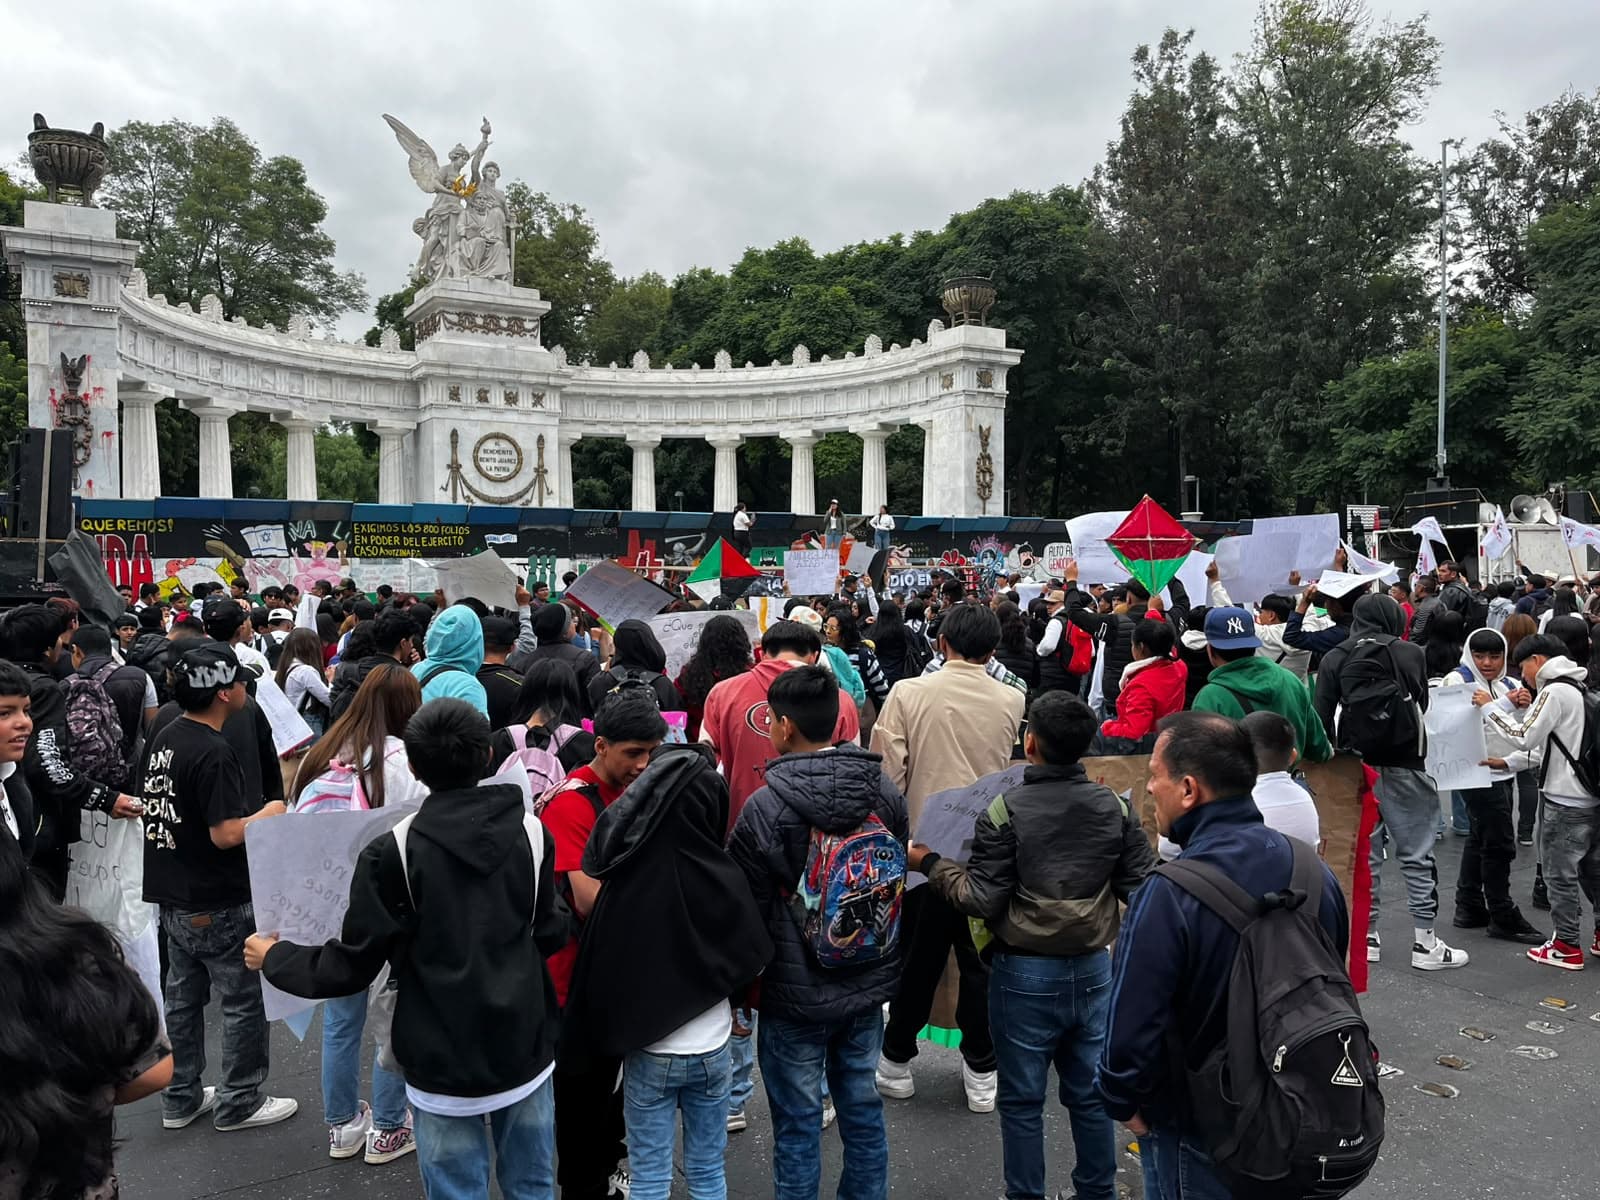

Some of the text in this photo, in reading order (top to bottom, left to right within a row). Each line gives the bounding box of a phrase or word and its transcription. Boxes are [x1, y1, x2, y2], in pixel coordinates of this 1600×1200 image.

[353, 523, 399, 534] EXIGIMOS
[401, 523, 422, 534] LOS
[423, 524, 440, 535] 800
[440, 525, 471, 535] FOLIOS
[354, 535, 465, 547] EN PODER DEL EJERCITO
[353, 545, 379, 557] CASO
[1048, 545, 1064, 557] ALTO
